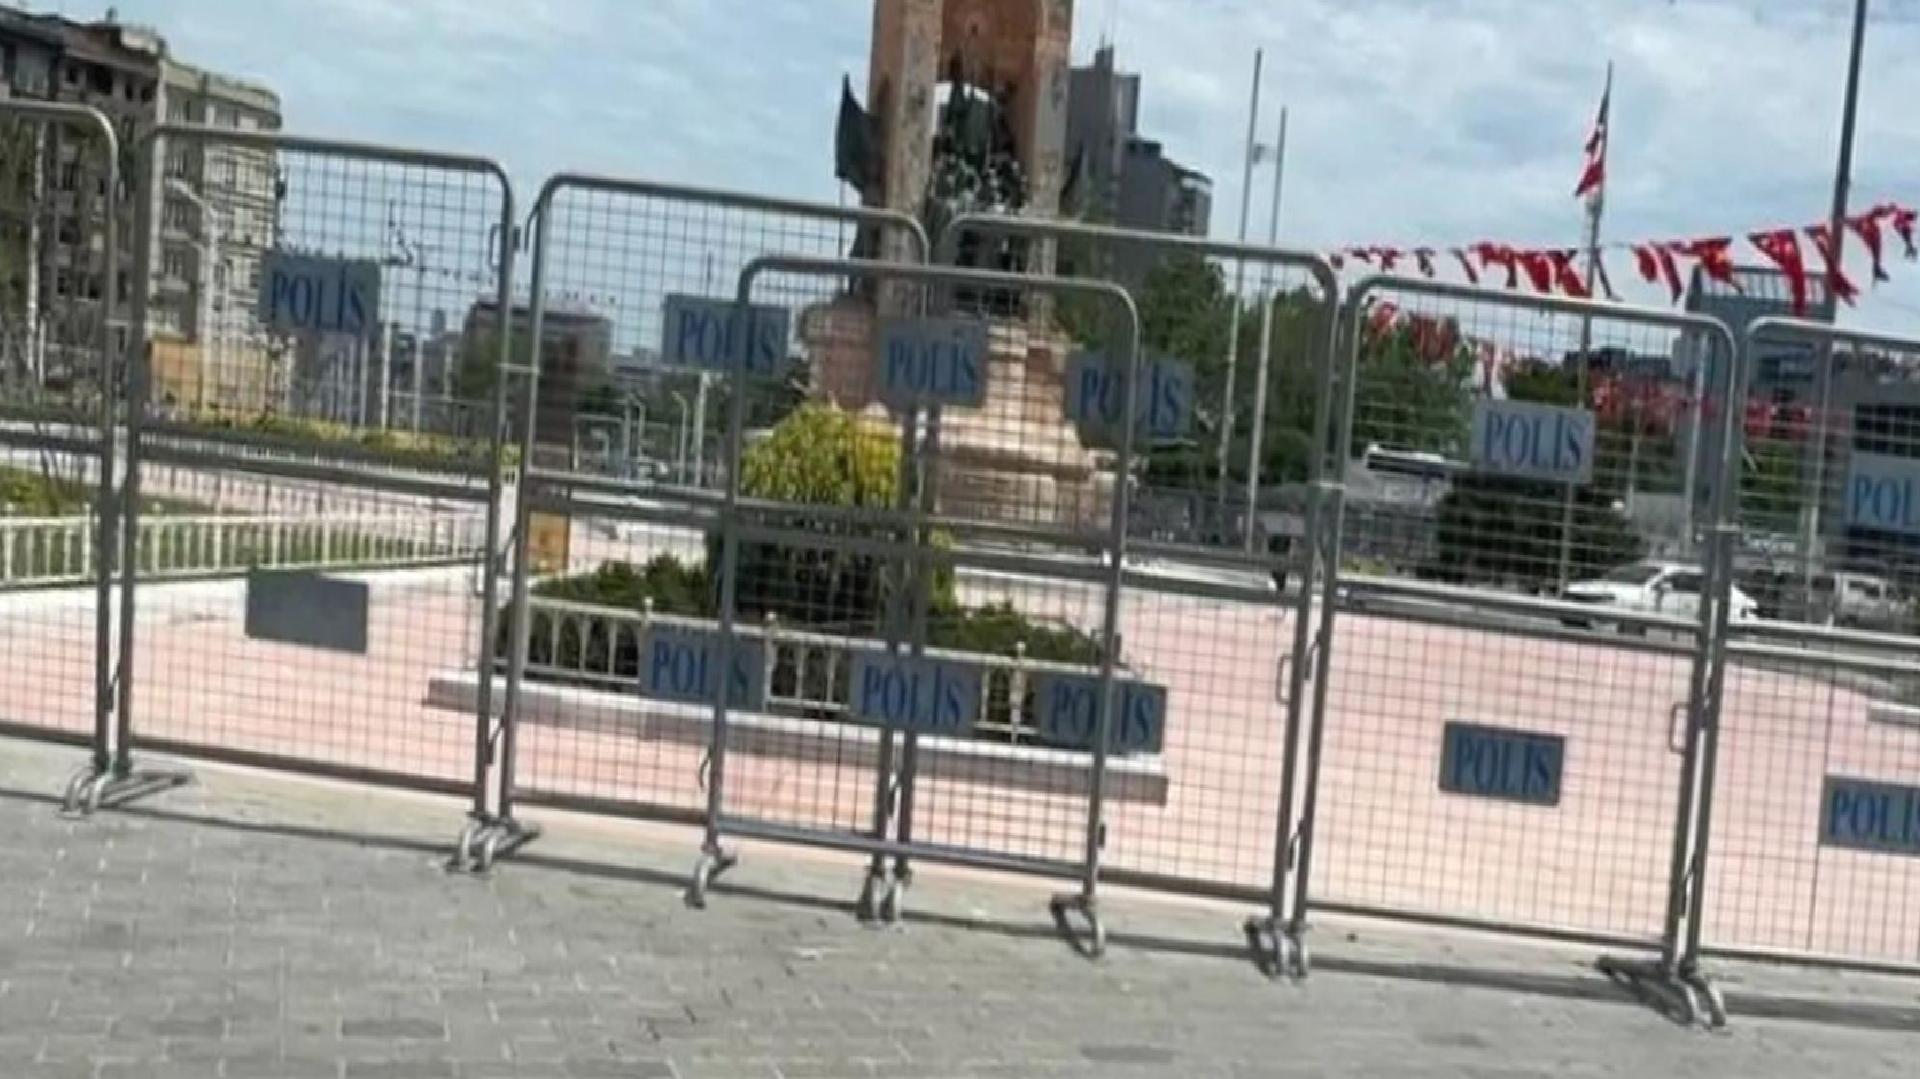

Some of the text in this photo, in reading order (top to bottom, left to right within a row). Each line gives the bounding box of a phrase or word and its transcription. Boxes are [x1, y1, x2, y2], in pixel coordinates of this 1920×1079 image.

[1080, 363, 1183, 438] POİS
[1854, 474, 1920, 528] POL
[652, 637, 752, 704] POLS
[1049, 681, 1153, 744] POİS
[1829, 787, 1920, 845] POLİ
